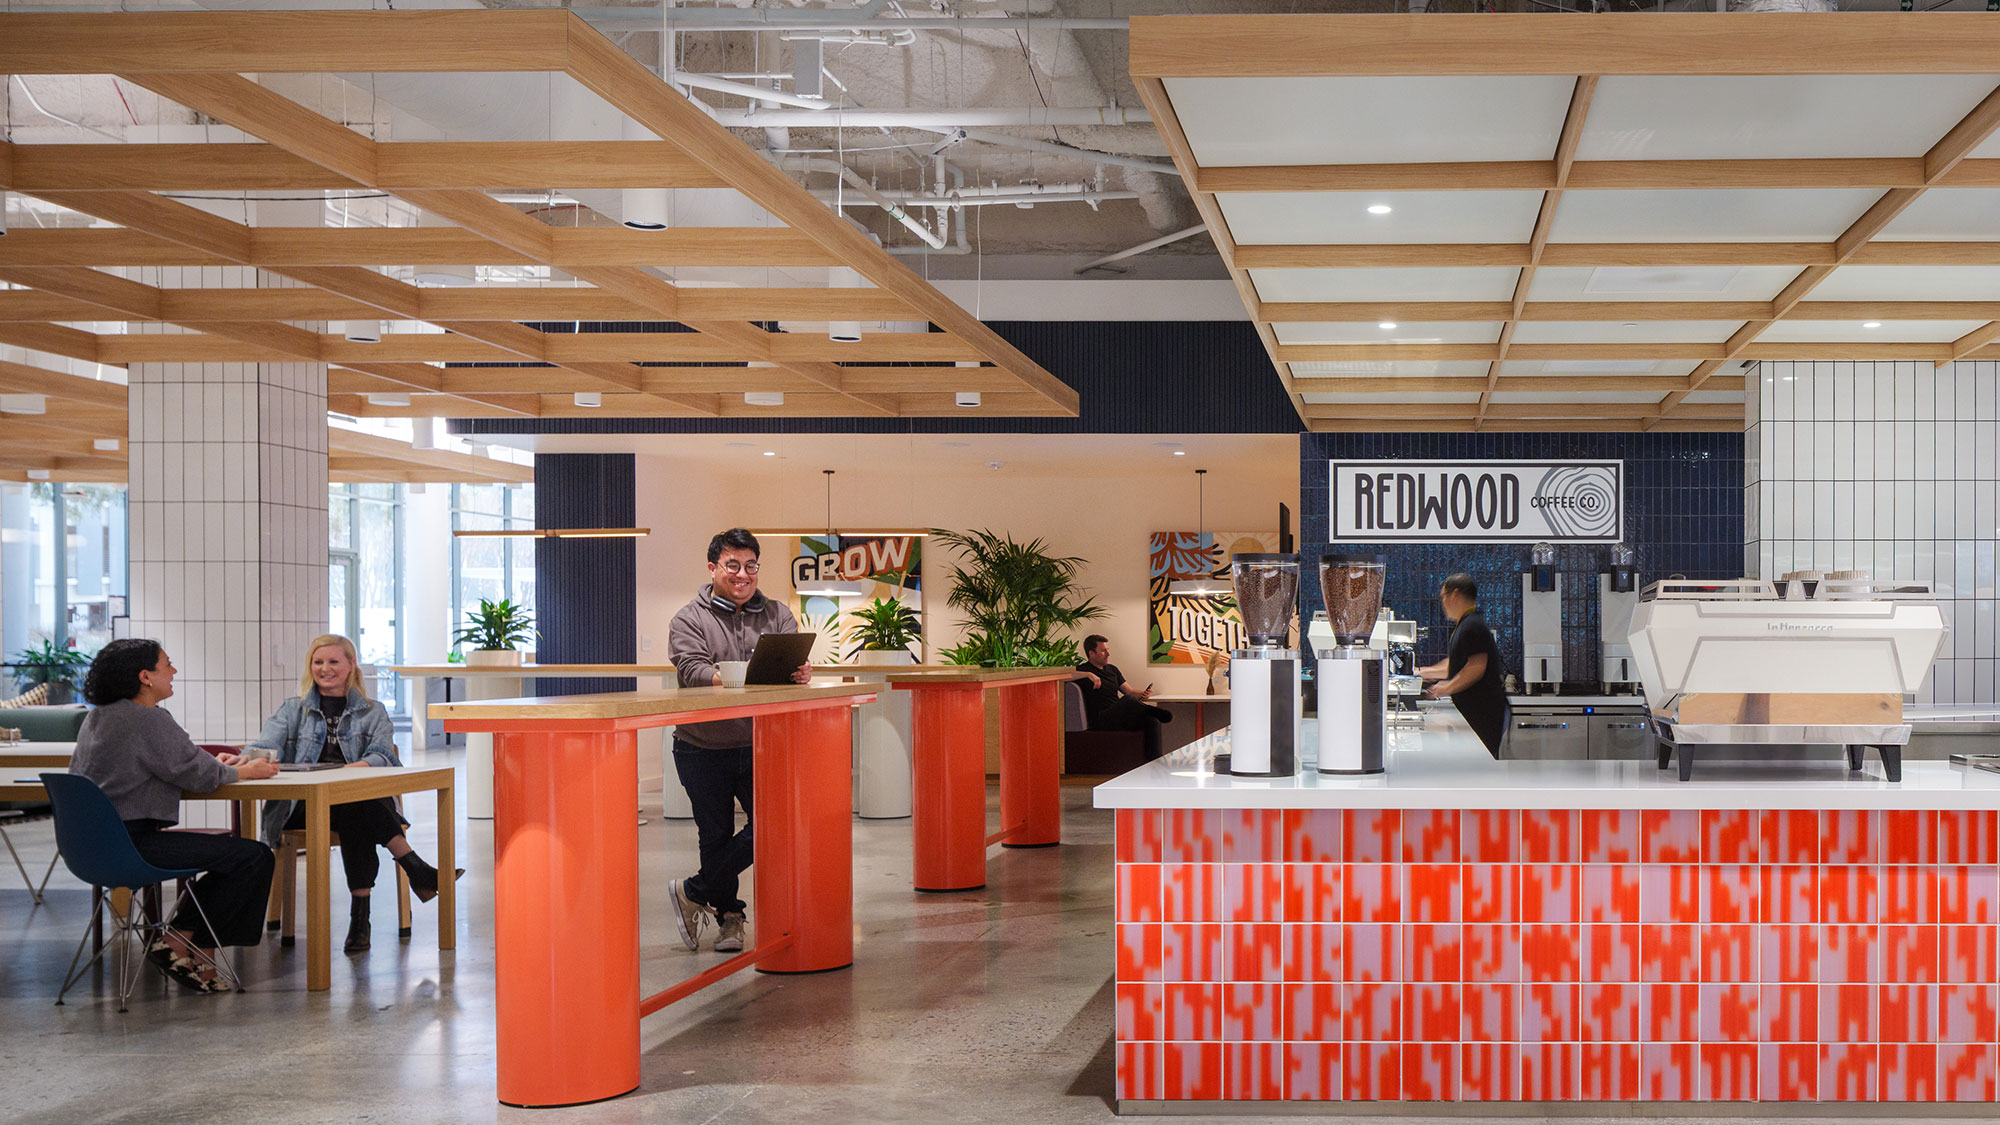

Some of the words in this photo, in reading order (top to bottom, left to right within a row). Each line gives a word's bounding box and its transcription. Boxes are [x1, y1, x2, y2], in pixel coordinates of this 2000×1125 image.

[1355, 473, 1519, 530] REDWOOD
[1530, 496, 1575, 509] COFFEE
[1579, 496, 1599, 509] CO.
[793, 536, 914, 584] GROW
[1168, 606, 1250, 653] TOGETH
